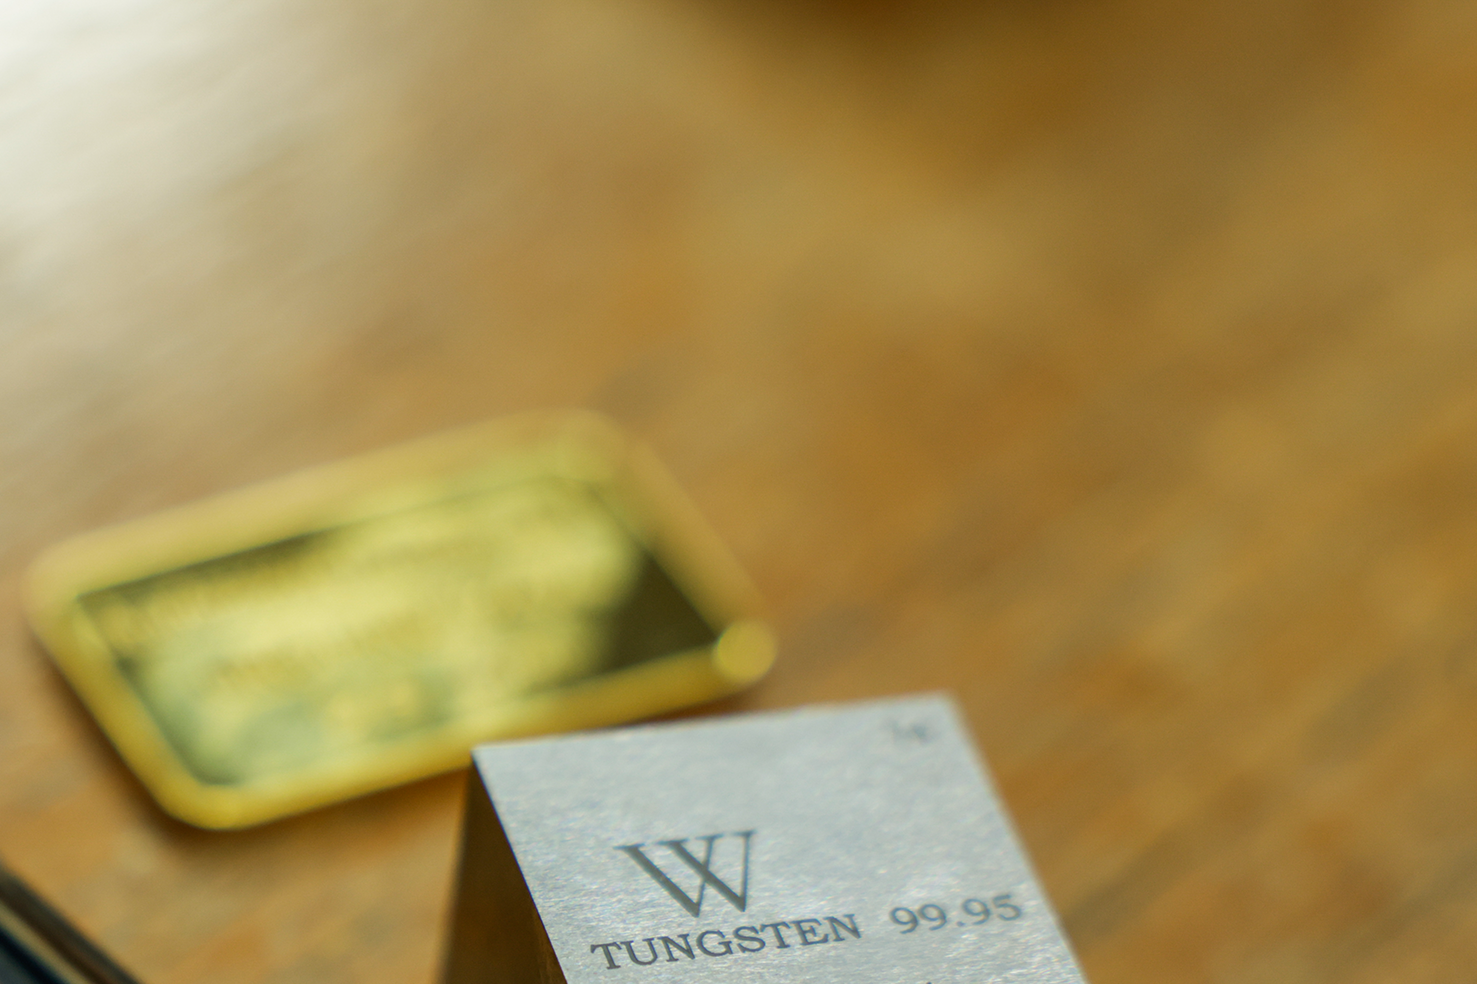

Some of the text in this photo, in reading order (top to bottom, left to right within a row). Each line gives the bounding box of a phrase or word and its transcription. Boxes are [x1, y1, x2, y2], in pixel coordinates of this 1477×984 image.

[614, 829, 757, 918] W
[590, 894, 1022, 970] TUNGSTEN 99.95
